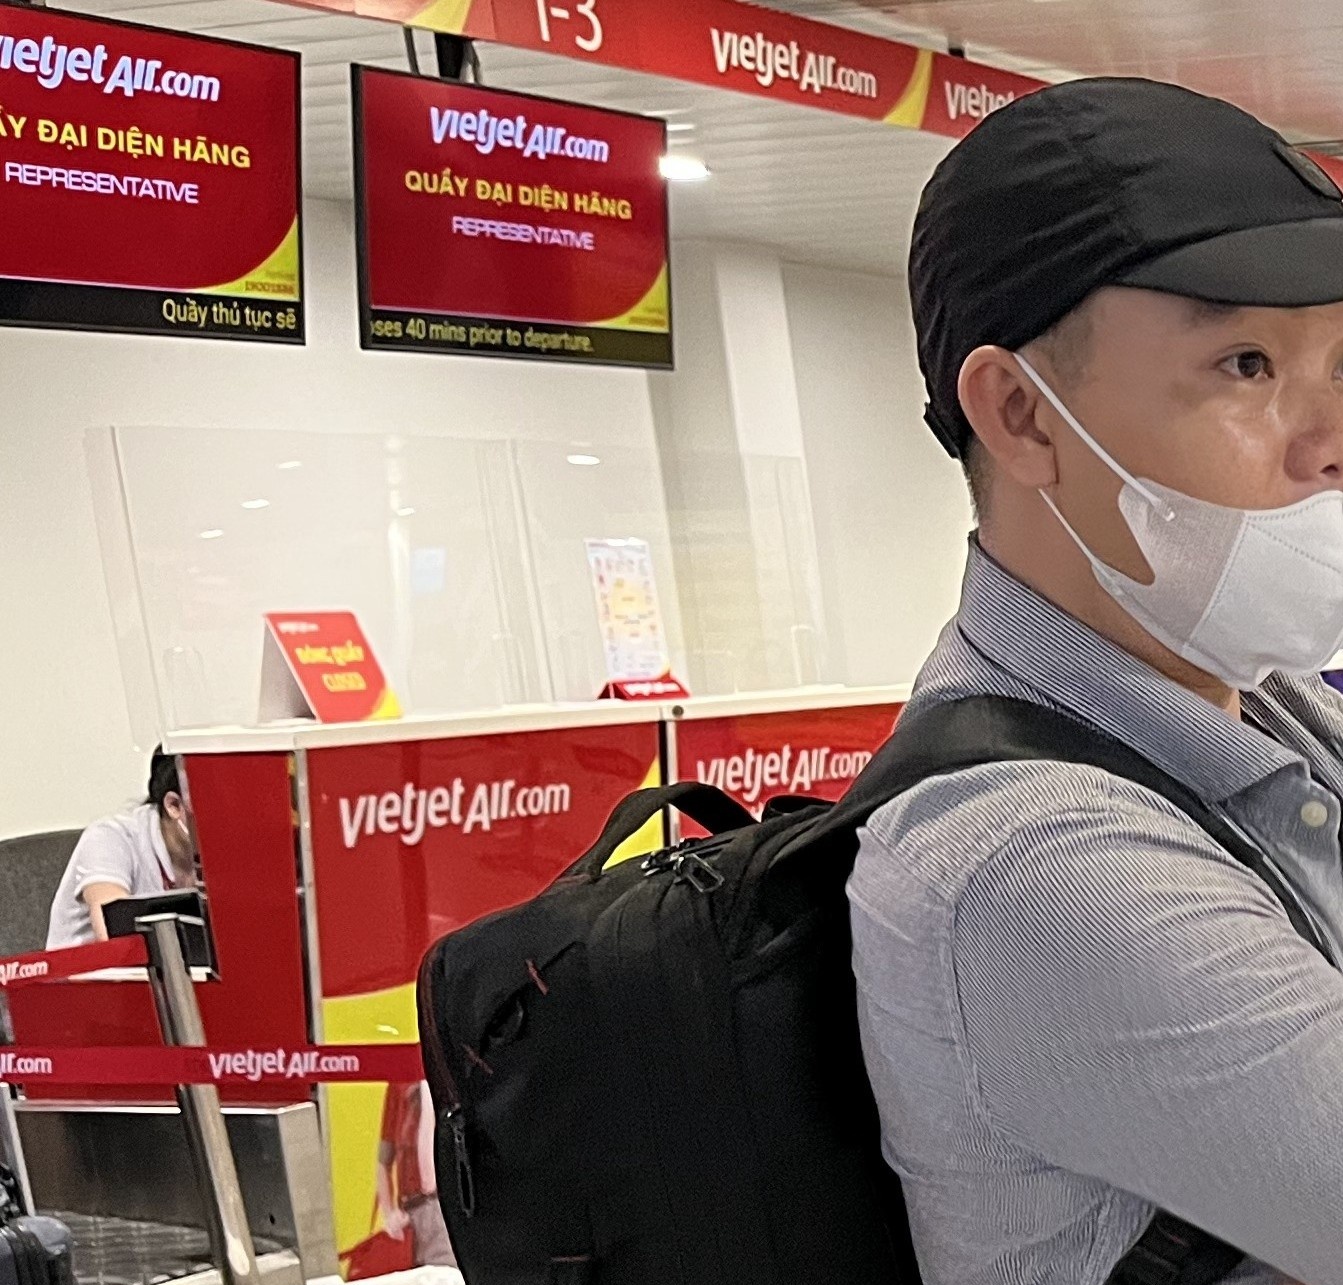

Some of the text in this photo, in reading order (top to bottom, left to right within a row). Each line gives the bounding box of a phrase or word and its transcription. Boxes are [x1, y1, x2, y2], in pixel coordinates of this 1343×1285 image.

[38, 119, 87, 150] ĐẠI
[98, 126, 164, 159] DIỆN
[174, 136, 251, 168] HÃNG
[5, 162, 199, 204] REPRESENTATIVE
[475, 179, 513, 207] ĐẠI
[518, 184, 568, 213] DIỆN
[573, 191, 633, 220] HÃNG
[451, 216, 596, 250] REPRESENTATIVE
[162, 297, 297, 331] Quầy thủ tục sẽ
[405, 318, 426, 339] 40
[429, 321, 466, 343] mins
[469, 327, 502, 346] prior
[506, 327, 522, 346] to
